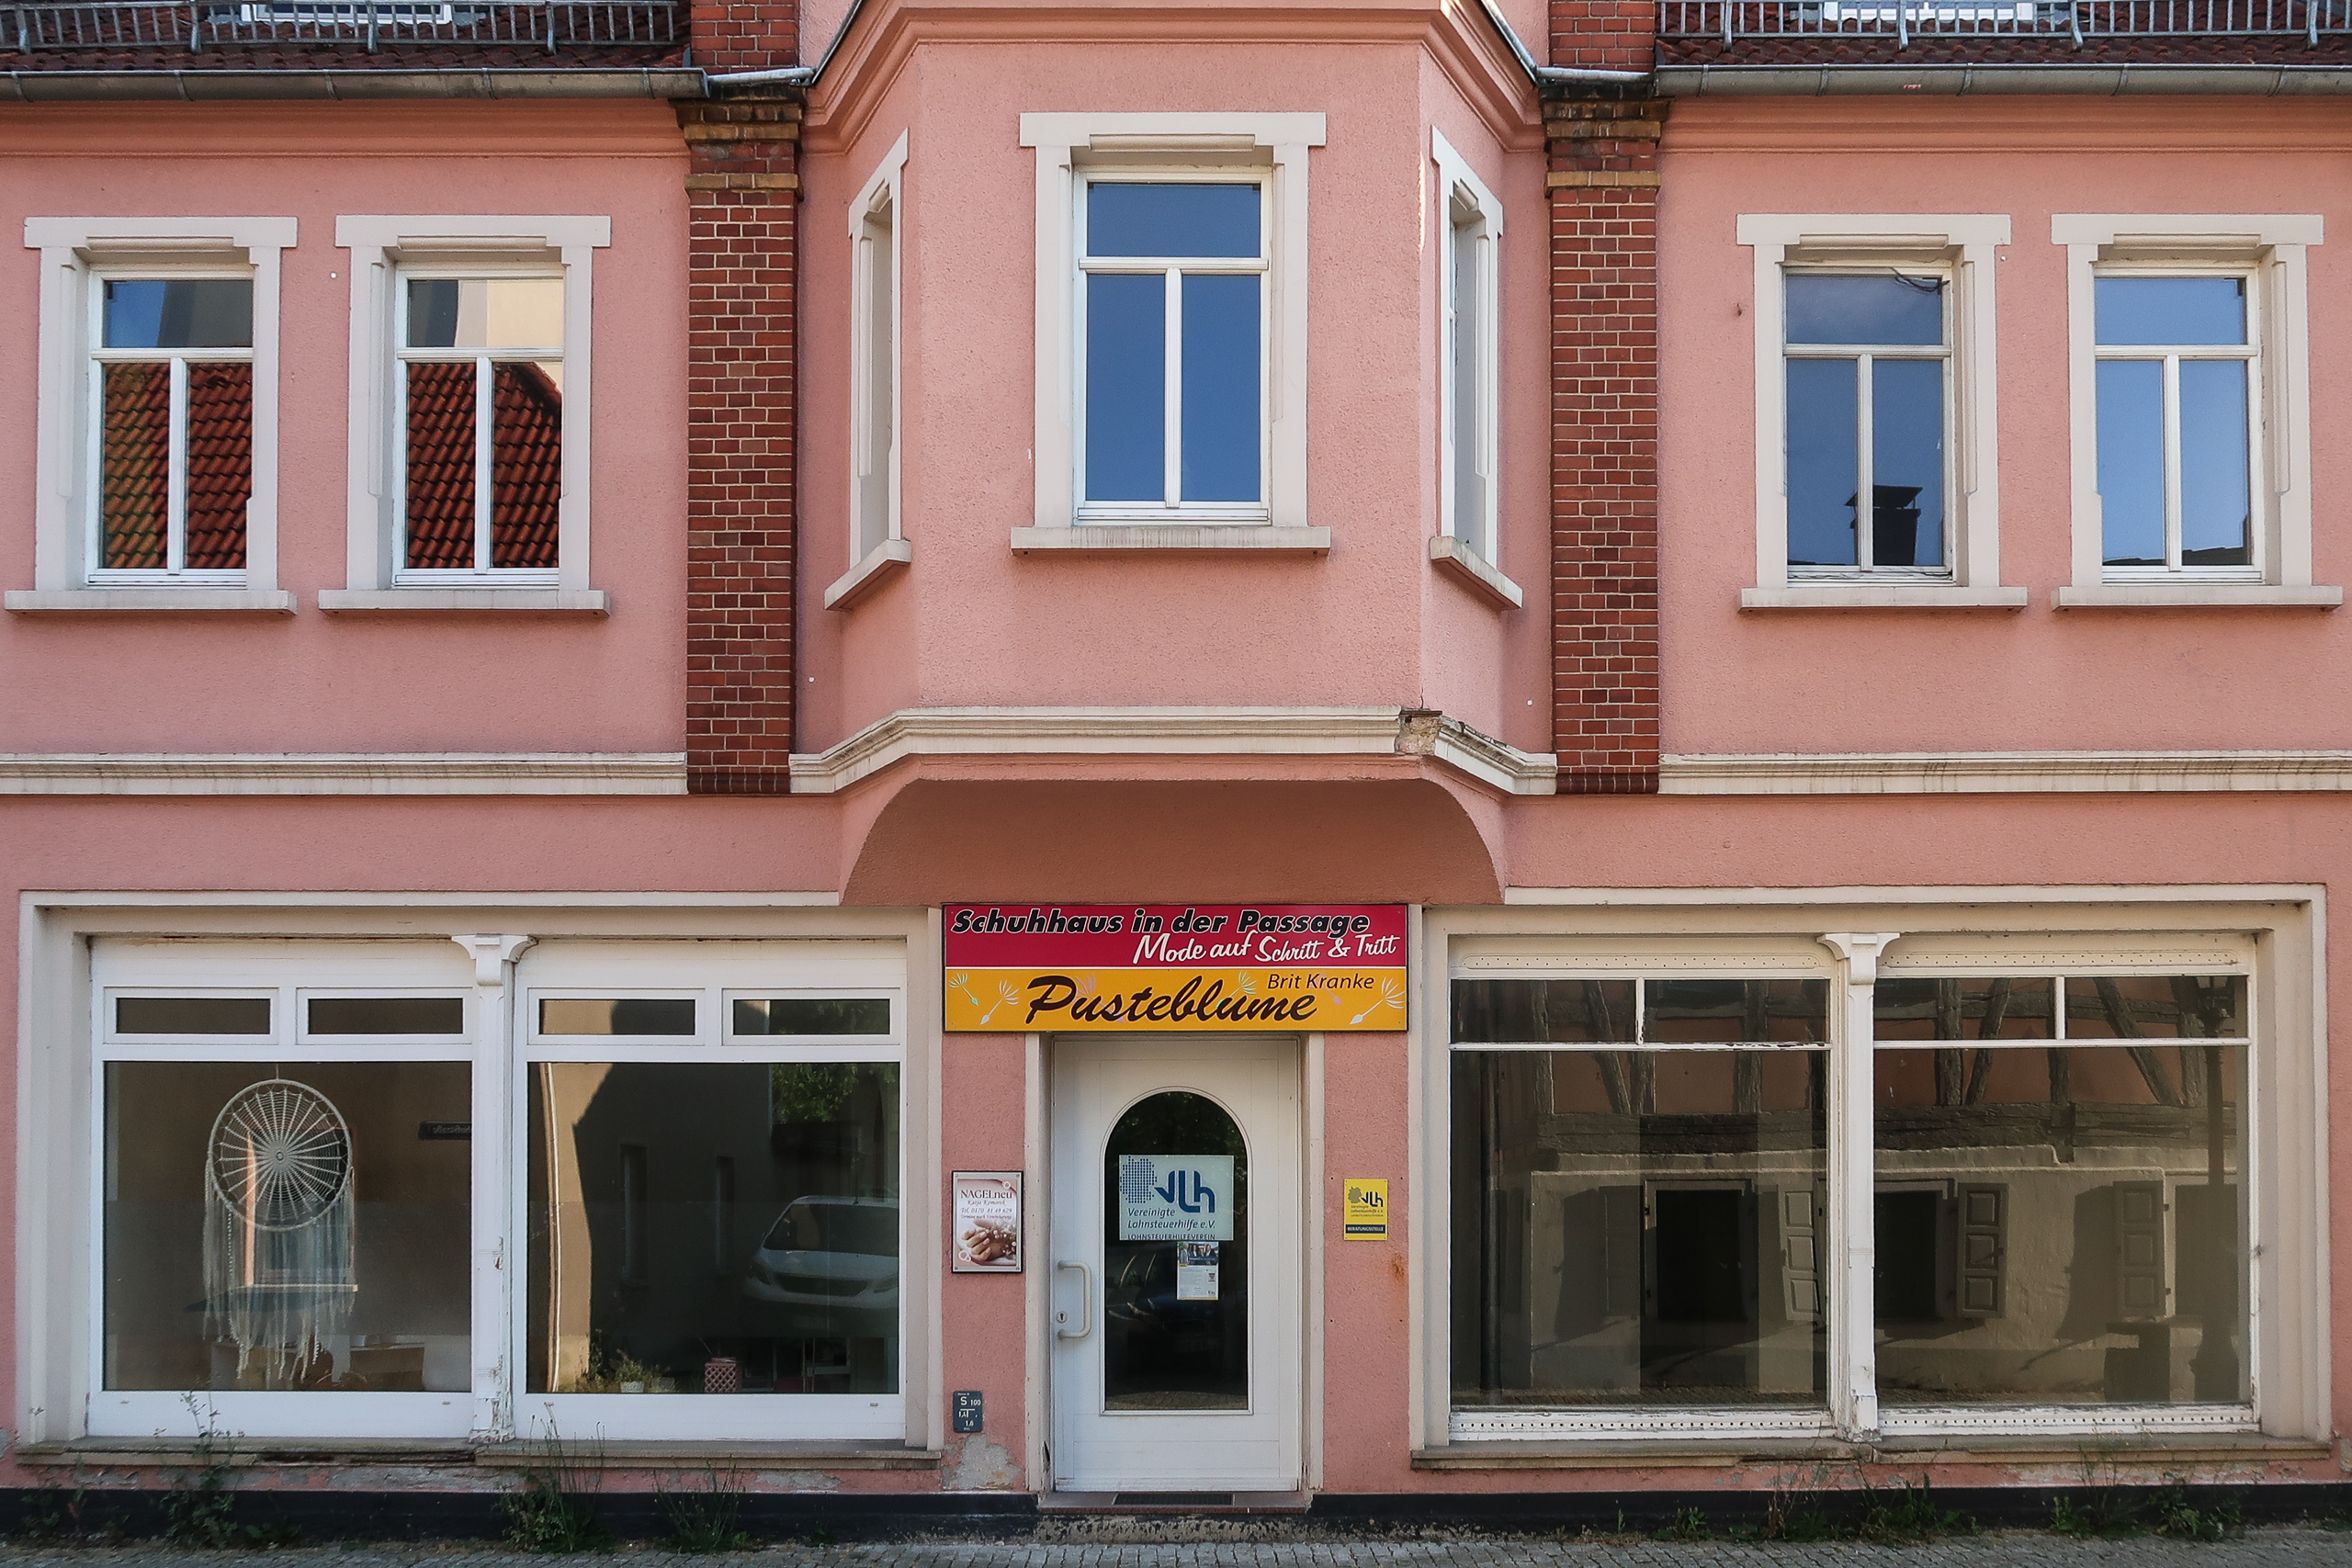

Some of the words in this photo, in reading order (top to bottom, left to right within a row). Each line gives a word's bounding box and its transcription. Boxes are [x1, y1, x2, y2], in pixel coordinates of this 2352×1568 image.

[951, 908, 1124, 934] Schuhhaus
[1131, 908, 1164, 933] in
[1171, 908, 1228, 933] der
[1237, 909, 1371, 940] Passage
[1132, 932, 1207, 964] Mode
[1209, 930, 1259, 958] auf
[1254, 935, 1325, 963] Schritt
[1327, 938, 1351, 957] &
[1354, 933, 1401, 957] Tritt
[1268, 974, 1302, 989] Brit
[1306, 973, 1375, 989] Kranke
[1024, 974, 1317, 1025] Pusteblume
[960, 1190, 1012, 1199] NAGELneu
[1127, 1207, 1176, 1219] Vereinigte
[1127, 1219, 1199, 1231] Lohnsteuerhilfe
[1200, 1220, 1216, 1229] e.V.
[960, 1396, 967, 1405] S
